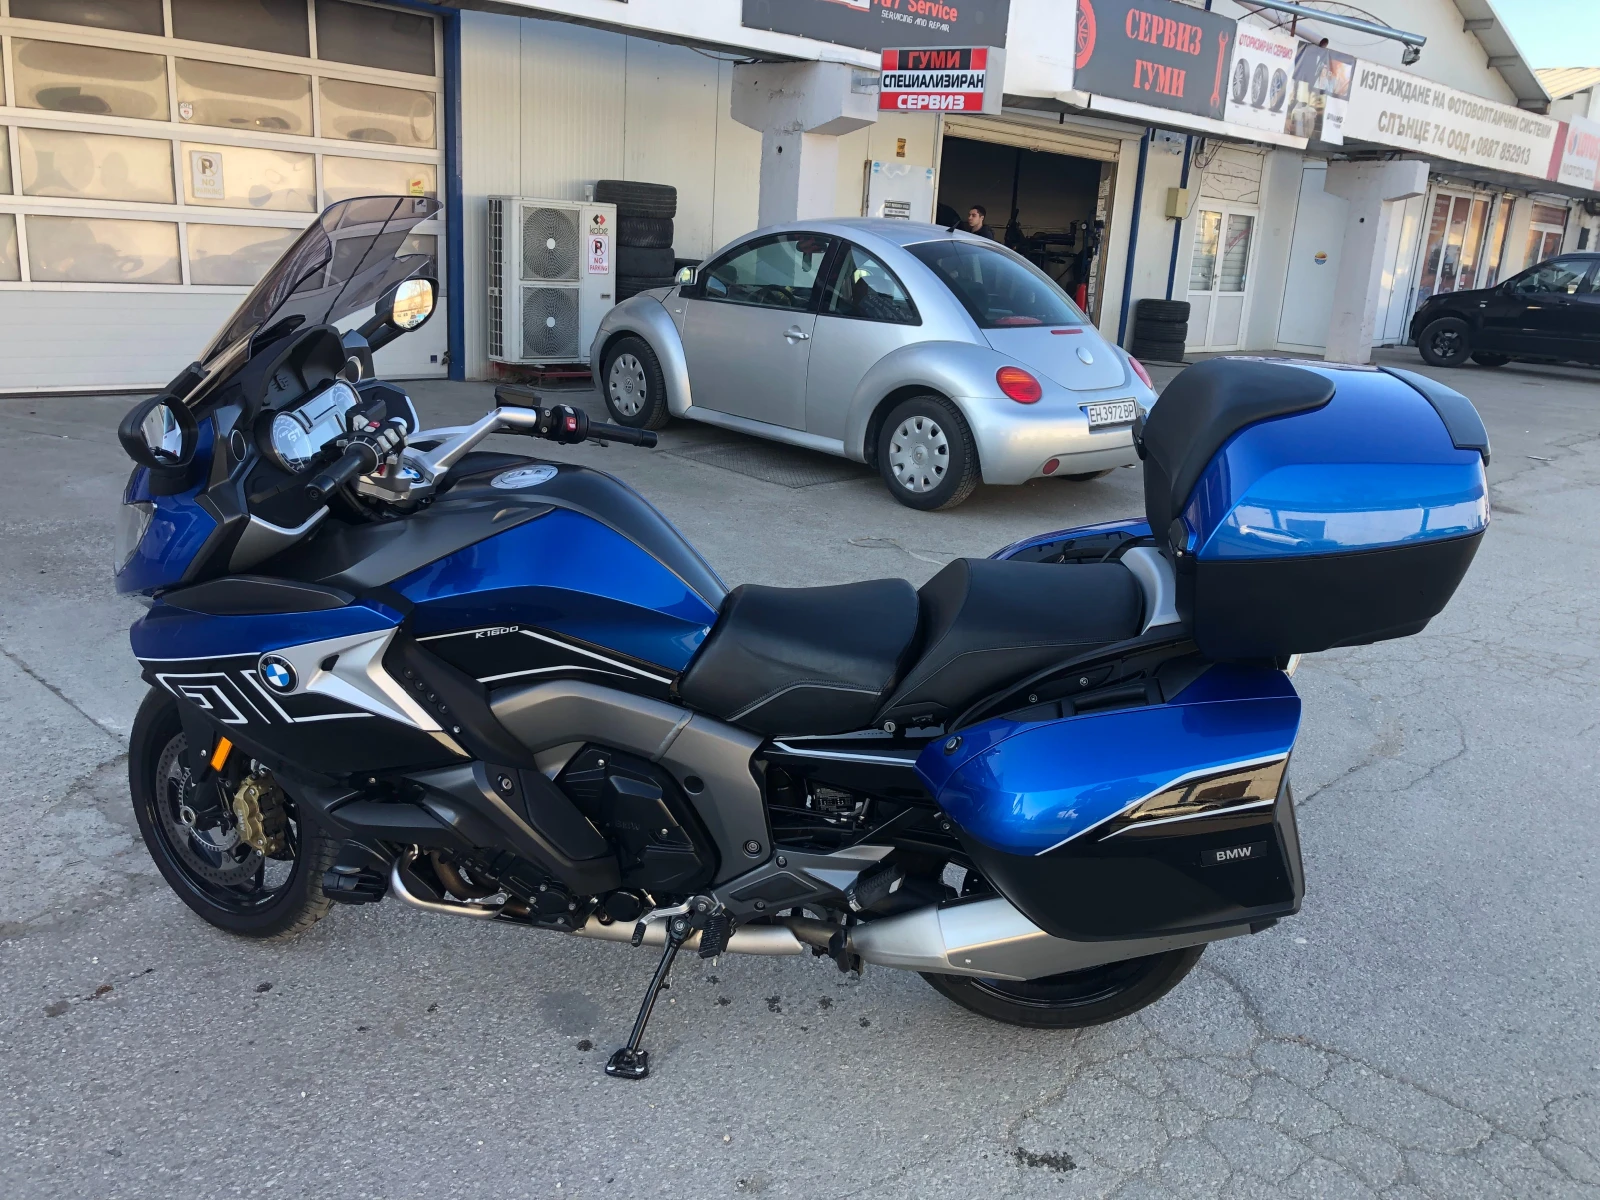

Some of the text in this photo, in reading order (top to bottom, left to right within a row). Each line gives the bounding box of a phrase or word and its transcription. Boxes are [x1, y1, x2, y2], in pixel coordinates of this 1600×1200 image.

[908, 0, 958, 21] Service
[881, 9, 950, 32] SERVICING AND REPAIR
[1125, 8, 1203, 56] СЕРВИЗ
[908, 50, 961, 69] ГУМИ
[1273, 44, 1293, 60] СЕРВИЗ
[882, 73, 984, 89] СПЕЦИАЛИЗИРАН
[1133, 59, 1187, 98] ГУМИ
[897, 94, 965, 110] СЕРВИЗ
[1359, 69, 1552, 139] ИЗГРАЖДАНЕ НА ФОТОВОЛТАИЧНИ СИСТЕМИ
[1378, 110, 1531, 165] СЛЪНЦЕ 74 ООД 0887 852913
[201, 178, 215, 187] NO
[196, 187, 222, 196] PARKING
[589, 225, 609, 235] kobe
[589, 264, 608, 272] PARKING
[594, 257, 604, 265] NO
[1216, 846, 1252, 861] BMW
